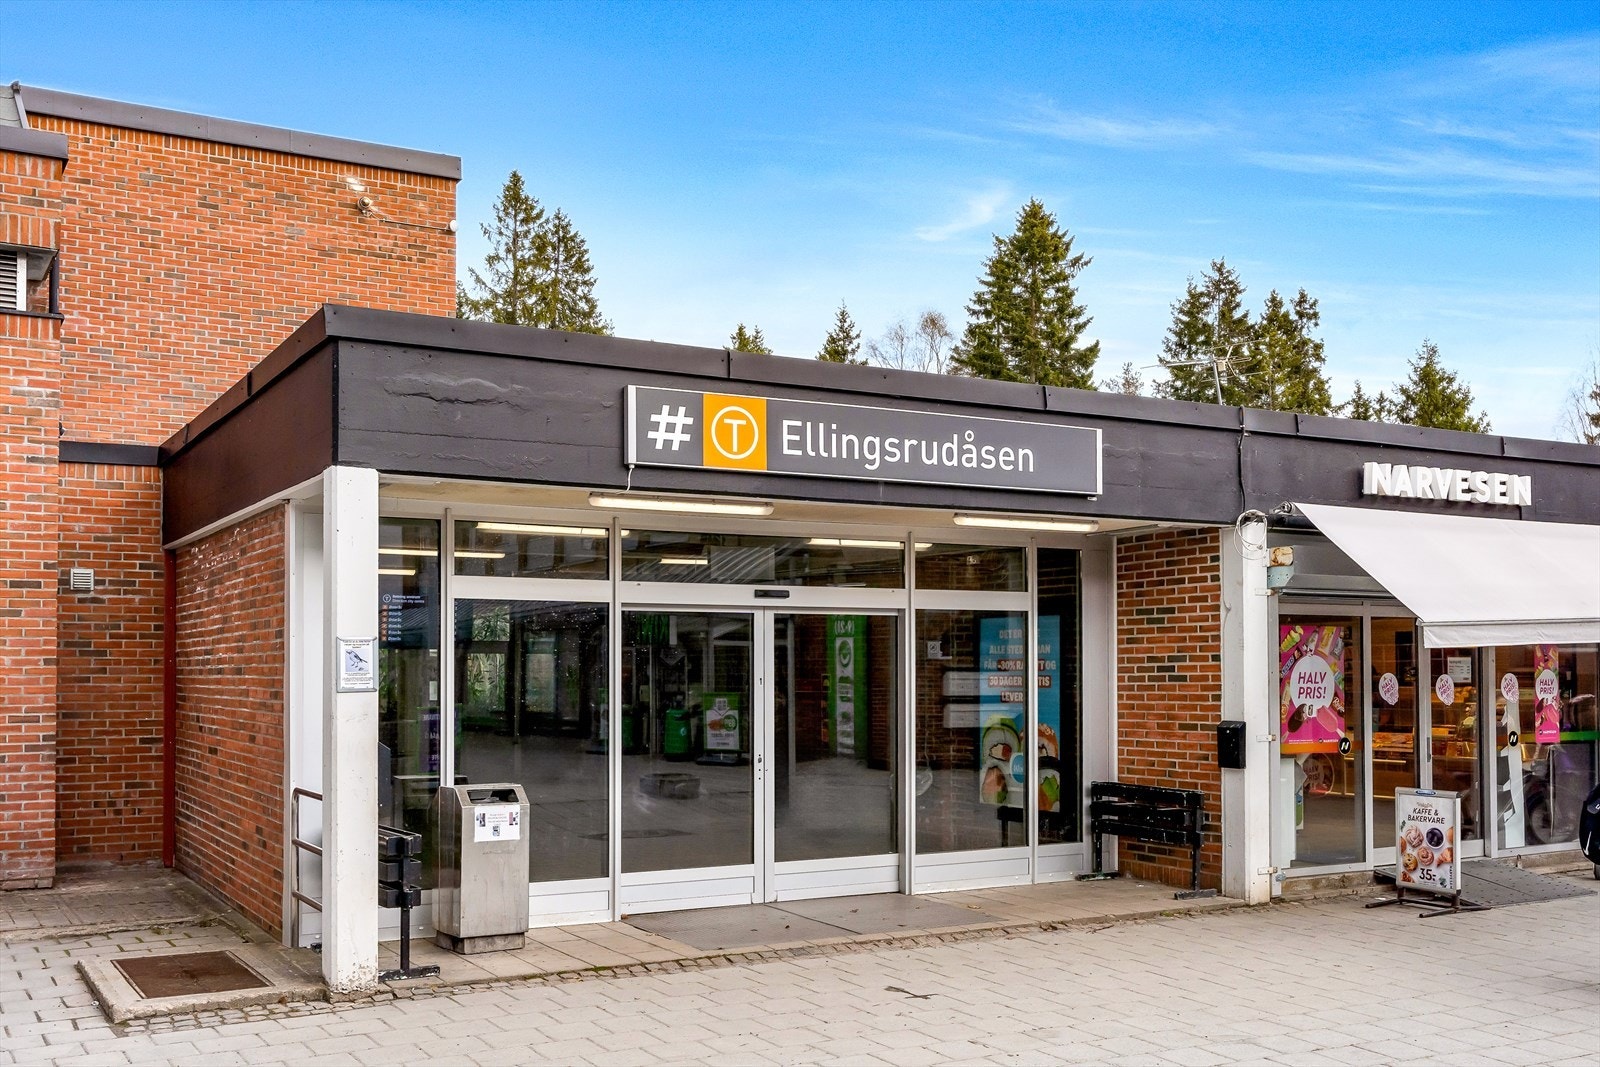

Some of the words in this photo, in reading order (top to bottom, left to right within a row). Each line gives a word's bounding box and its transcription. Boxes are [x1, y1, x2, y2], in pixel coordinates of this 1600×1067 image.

[781, 417, 1035, 473] Ellingsrudåsen
[1363, 462, 1532, 506] NARVESEN
[1046, 661, 1056, 669] OG
[990, 677, 998, 685] 30
[1000, 677, 1022, 685] DAGER
[1298, 672, 1327, 684] HALV
[1539, 679, 1555, 687] HALV
[1298, 687, 1327, 699] PRIS!
[1539, 687, 1555, 695] PRIS!
[1413, 808, 1432, 816] KAFFE
[1408, 815, 1445, 824] BAKERVARE
